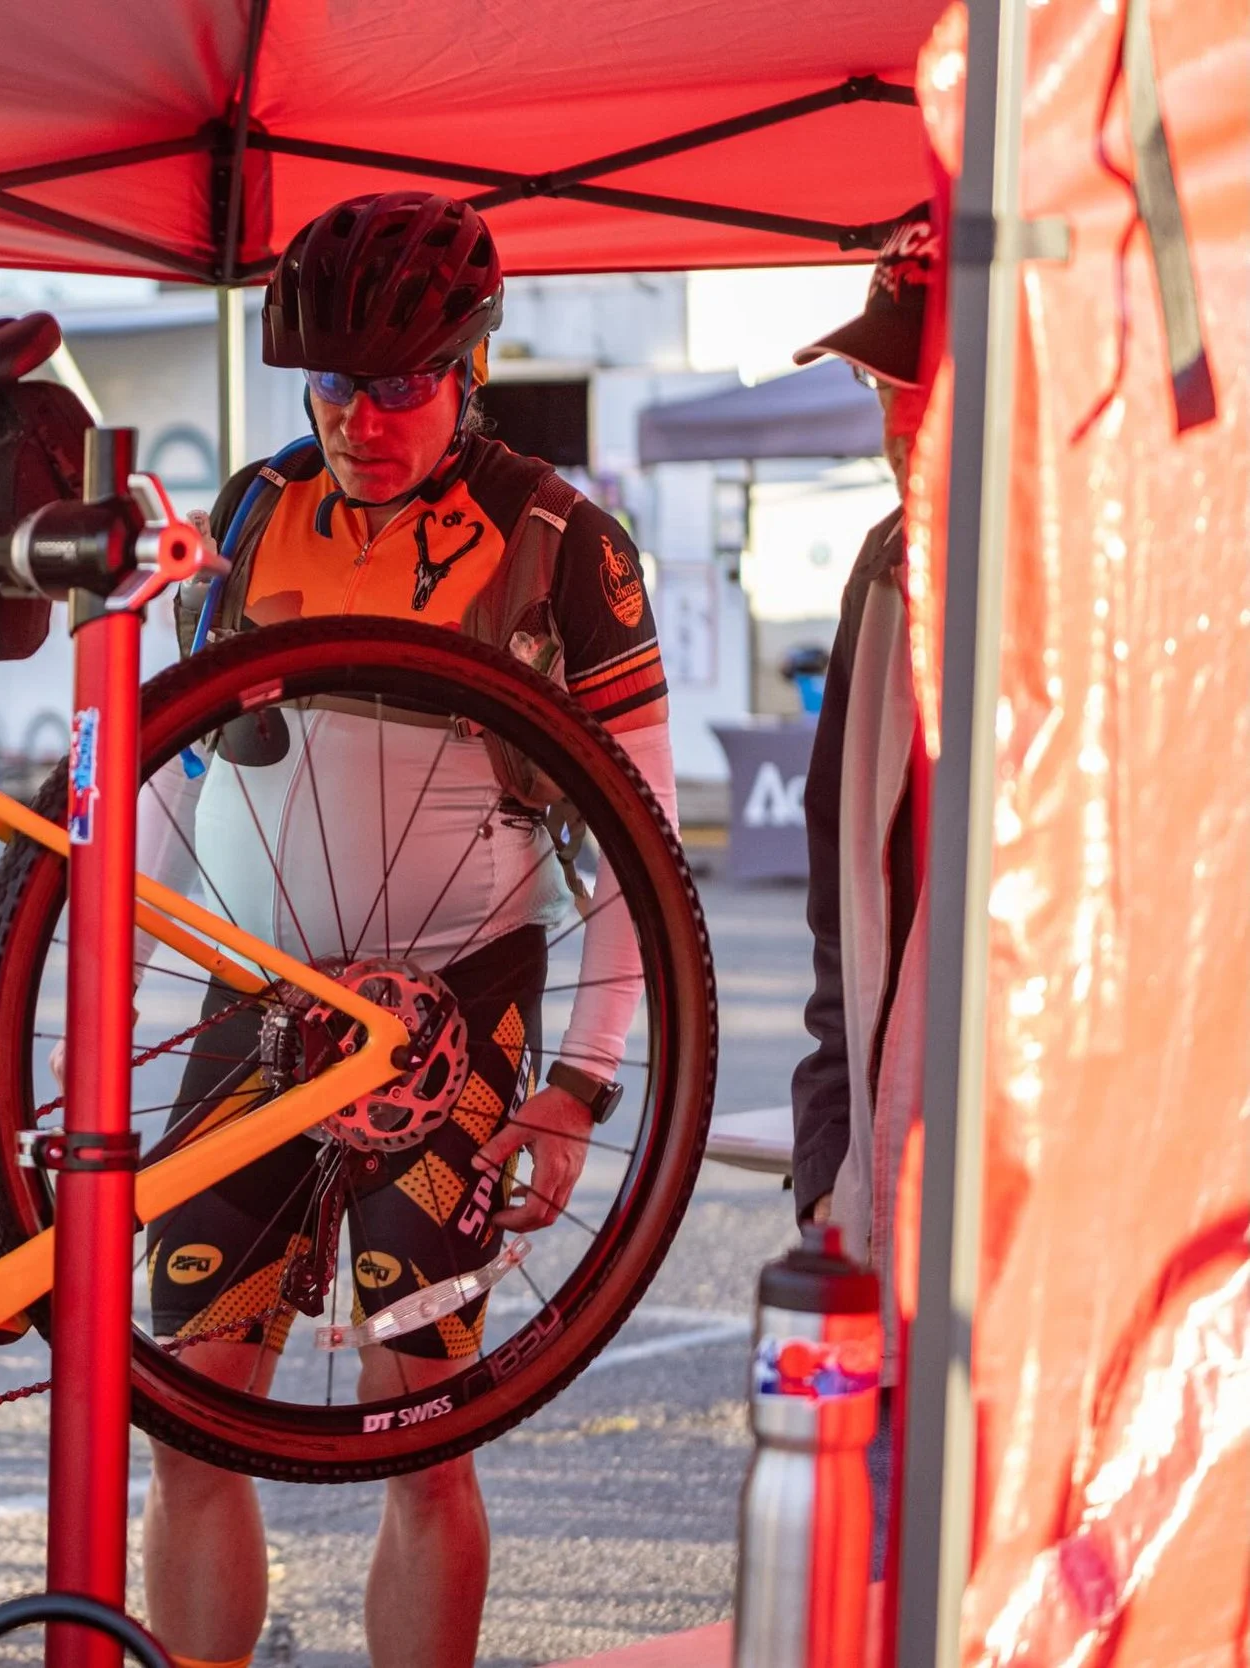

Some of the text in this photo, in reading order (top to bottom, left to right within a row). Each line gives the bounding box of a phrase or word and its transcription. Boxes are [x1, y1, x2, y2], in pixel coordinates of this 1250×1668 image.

[537, 509, 560, 524] CHASE
[610, 580, 640, 606] LANDER
[363, 1411, 395, 1433] DT
[398, 1395, 453, 1428] SWISS
